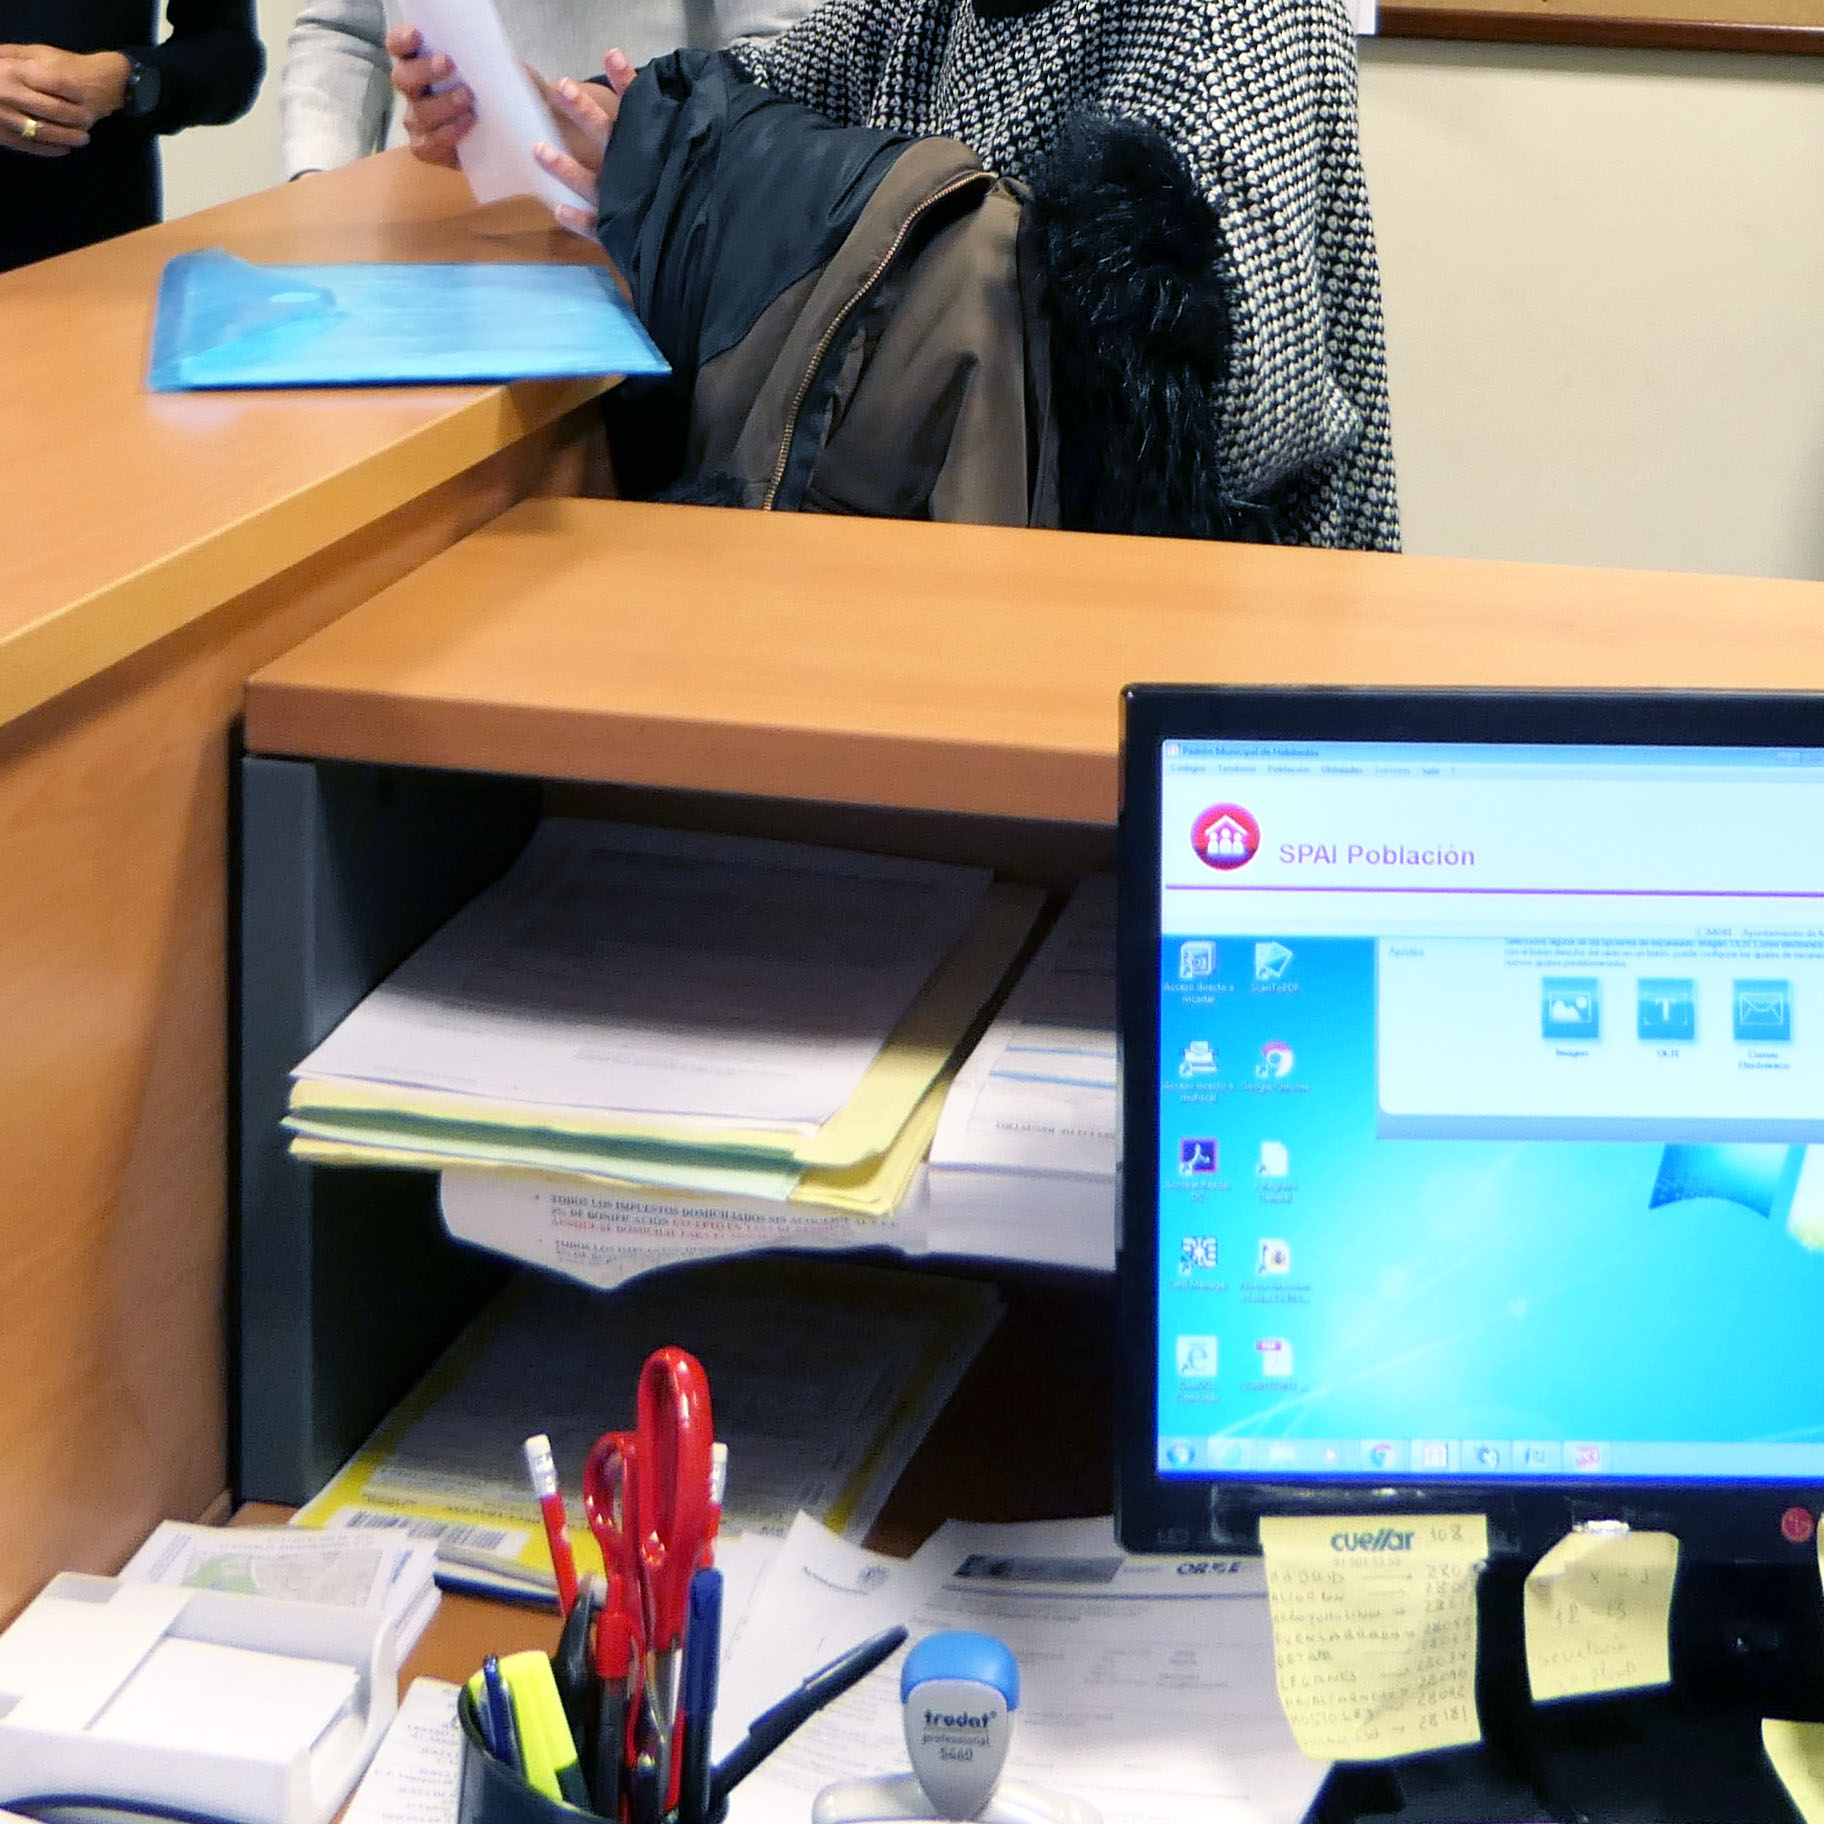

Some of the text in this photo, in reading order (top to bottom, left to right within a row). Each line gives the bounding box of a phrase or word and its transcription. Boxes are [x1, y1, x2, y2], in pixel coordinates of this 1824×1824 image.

[1279, 843, 1476, 866] SPAI Población
[1330, 1528, 1415, 1553] cuellar
[924, 1709, 989, 1728] trodat
